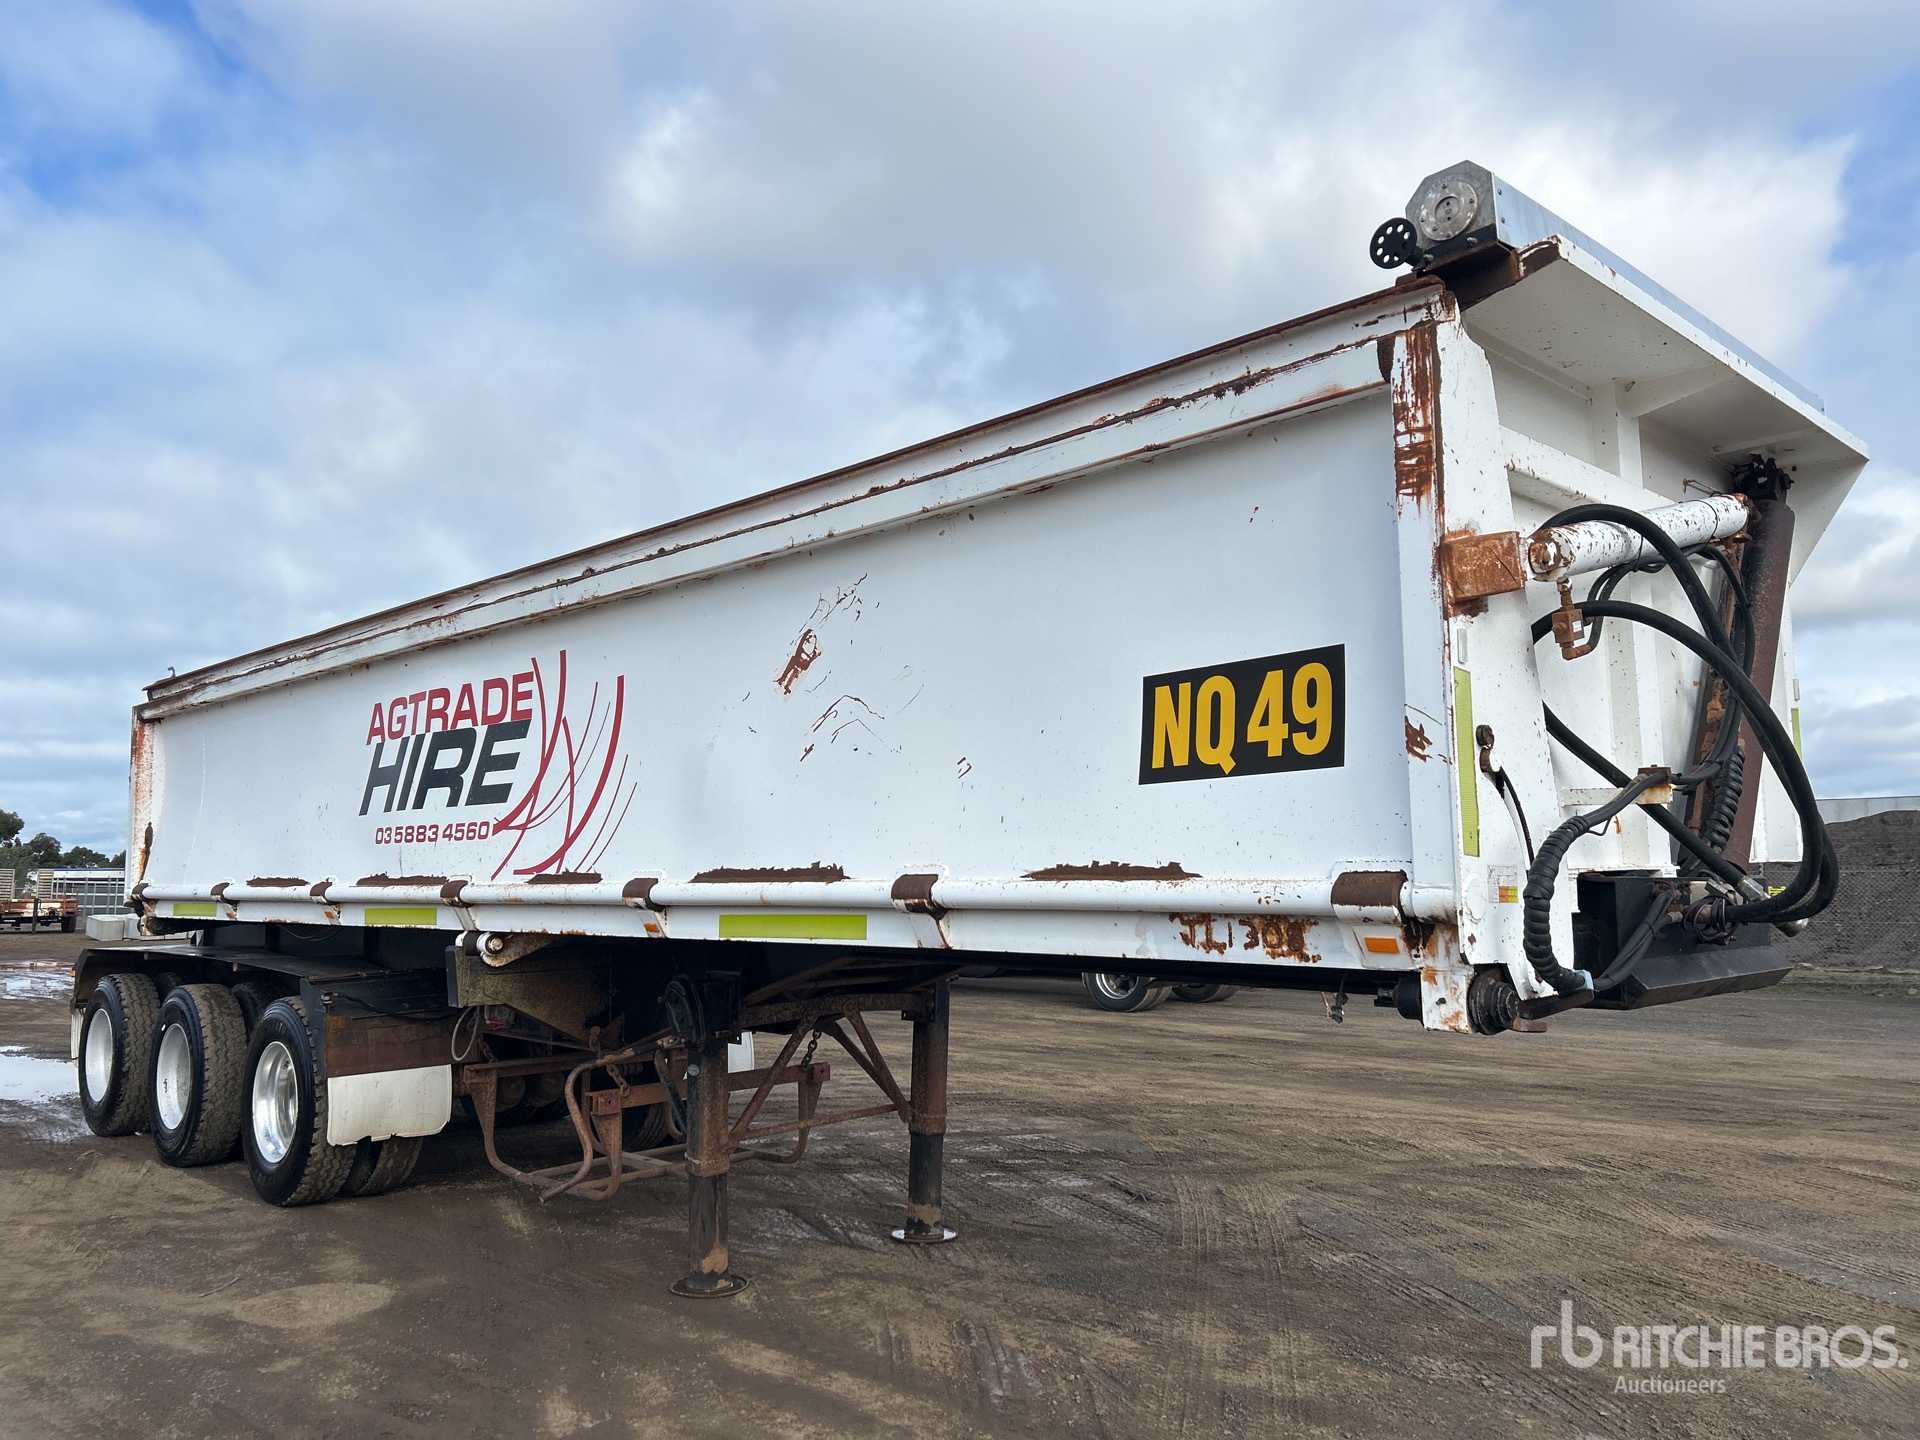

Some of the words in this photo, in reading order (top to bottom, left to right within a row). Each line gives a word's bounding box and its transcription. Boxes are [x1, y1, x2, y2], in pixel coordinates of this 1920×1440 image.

[366, 671, 534, 745] AGTRADE
[1151, 675, 1236, 775] NQ
[1247, 662, 1333, 758] 49
[358, 719, 532, 816] HIRE
[441, 821, 490, 842] 4560
